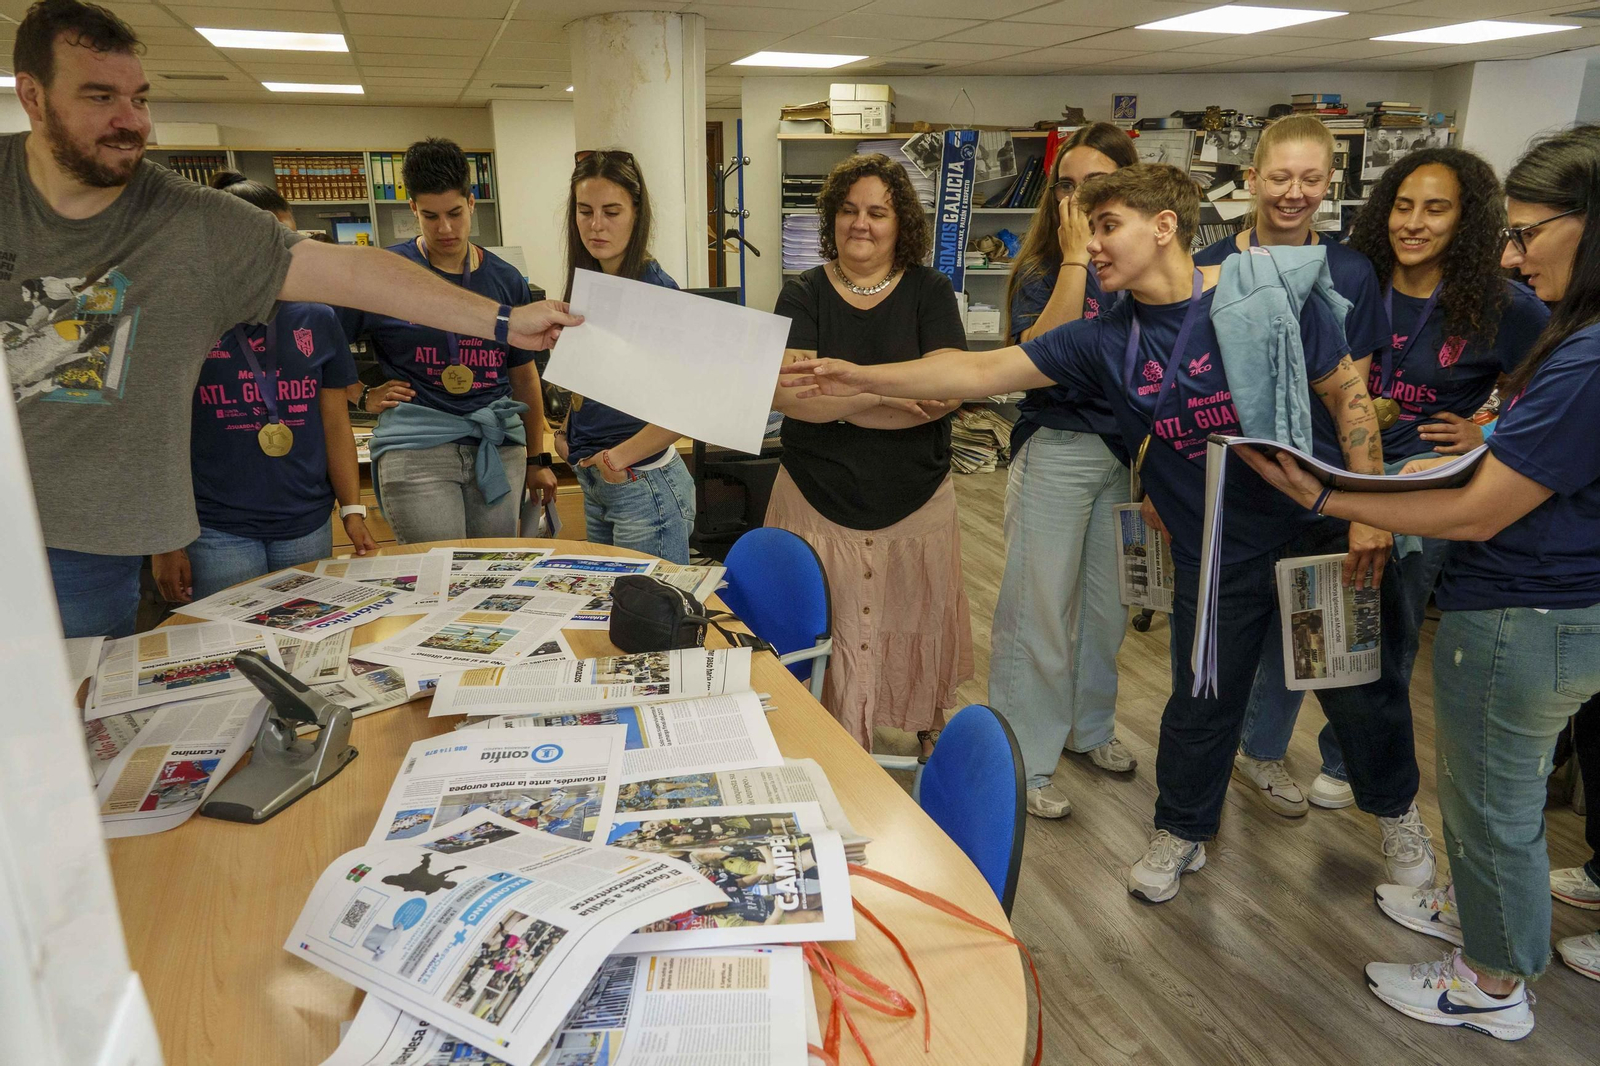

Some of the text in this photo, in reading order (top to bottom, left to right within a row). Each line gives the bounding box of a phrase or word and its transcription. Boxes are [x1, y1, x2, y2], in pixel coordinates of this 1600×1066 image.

[415, 346, 506, 368] ATL. UARDÉS
[1190, 364, 1212, 376] ZICO
[200, 384, 238, 405] ATL.
[1188, 391, 1232, 408] Mecalia
[1155, 417, 1194, 440] ATL.
[316, 598, 394, 628] Atlántico
[480, 750, 529, 763] confía
[449, 783, 488, 792] europea
[570, 864, 669, 910] para reencontrarse
[620, 874, 670, 894] Guardés,
[467, 878, 528, 922] BALONMANO
[578, 898, 616, 917] Sicilia
[421, 942, 454, 984] DEPORTE
